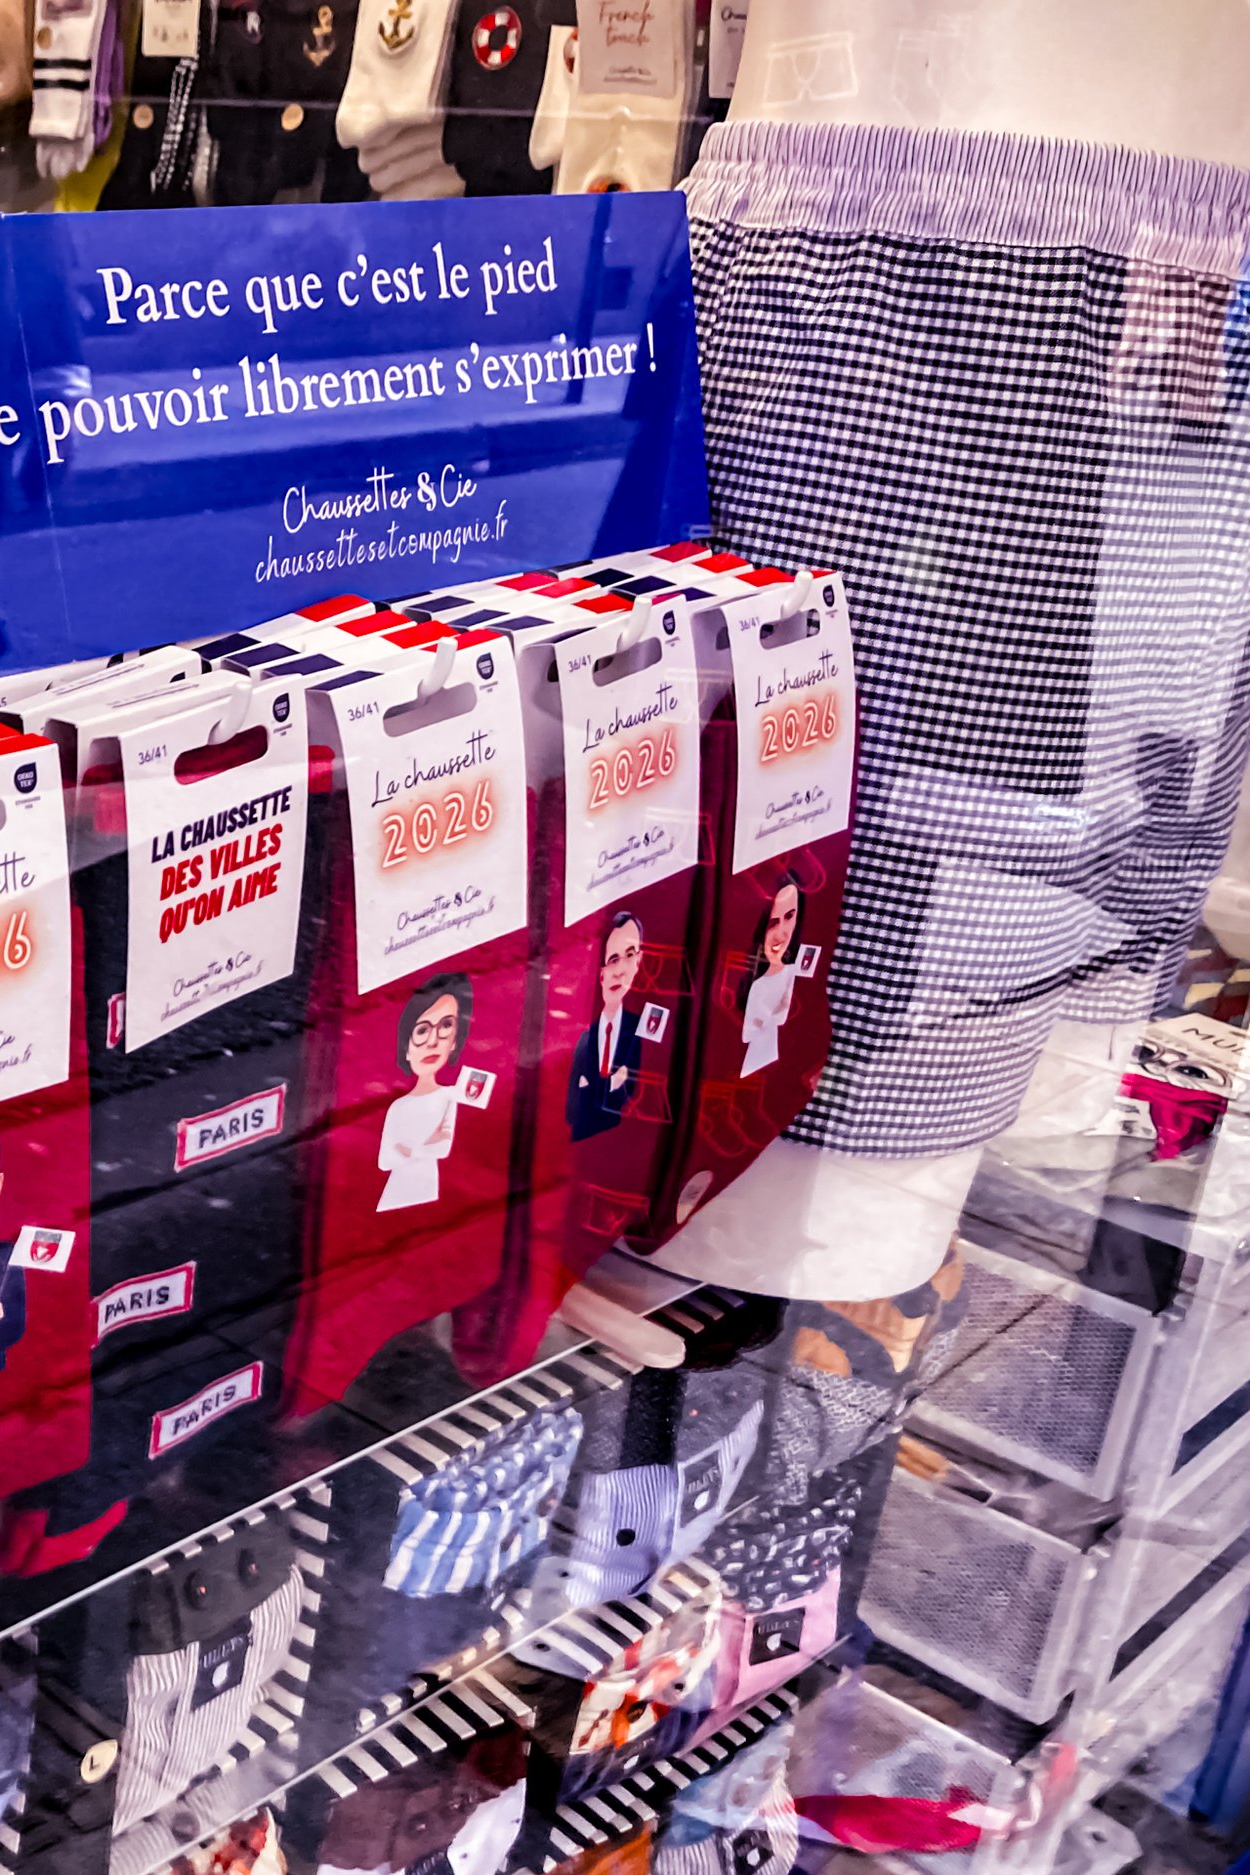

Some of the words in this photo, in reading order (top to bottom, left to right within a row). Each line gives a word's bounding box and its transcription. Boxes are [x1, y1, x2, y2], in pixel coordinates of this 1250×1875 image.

[96, 267, 230, 326] Parce
[245, 271, 324, 334] que
[336, 255, 428, 307] c'est
[433, 243, 470, 302] le
[480, 237, 558, 316] pied
[39, 369, 229, 465] pouvoir
[238, 353, 445, 418] librement
[455, 334, 638, 404] s'exprimer
[647, 323, 657, 372] !
[283, 467, 411, 534] Chaussettes
[417, 473, 437, 511] &
[440, 464, 477, 509] Cie
[255, 501, 508, 584] chaussettesetcompagnie.fr
[347, 701, 380, 721] 36/41
[755, 676, 775, 707] La
[777, 649, 839, 694] chaussette
[582, 719, 606, 753] La
[608, 681, 678, 735] chaussette
[760, 695, 837, 763] 2026
[138, 745, 168, 766] 36/41
[371, 771, 400, 808] La
[404, 729, 496, 788] chaussette
[589, 731, 676, 811] 2026
[151, 834, 174, 863] LA
[179, 785, 293, 852] CHAUSSETTE
[381, 782, 493, 869] 2026
[159, 860, 202, 901] DES
[210, 824, 284, 879] VILLES
[159, 897, 221, 944] QU'ON
[227, 862, 282, 912] AIME
[198, 1108, 265, 1149] PARIS
[104, 1285, 170, 1323] PARIS
[172, 1384, 236, 1435] PARIS
